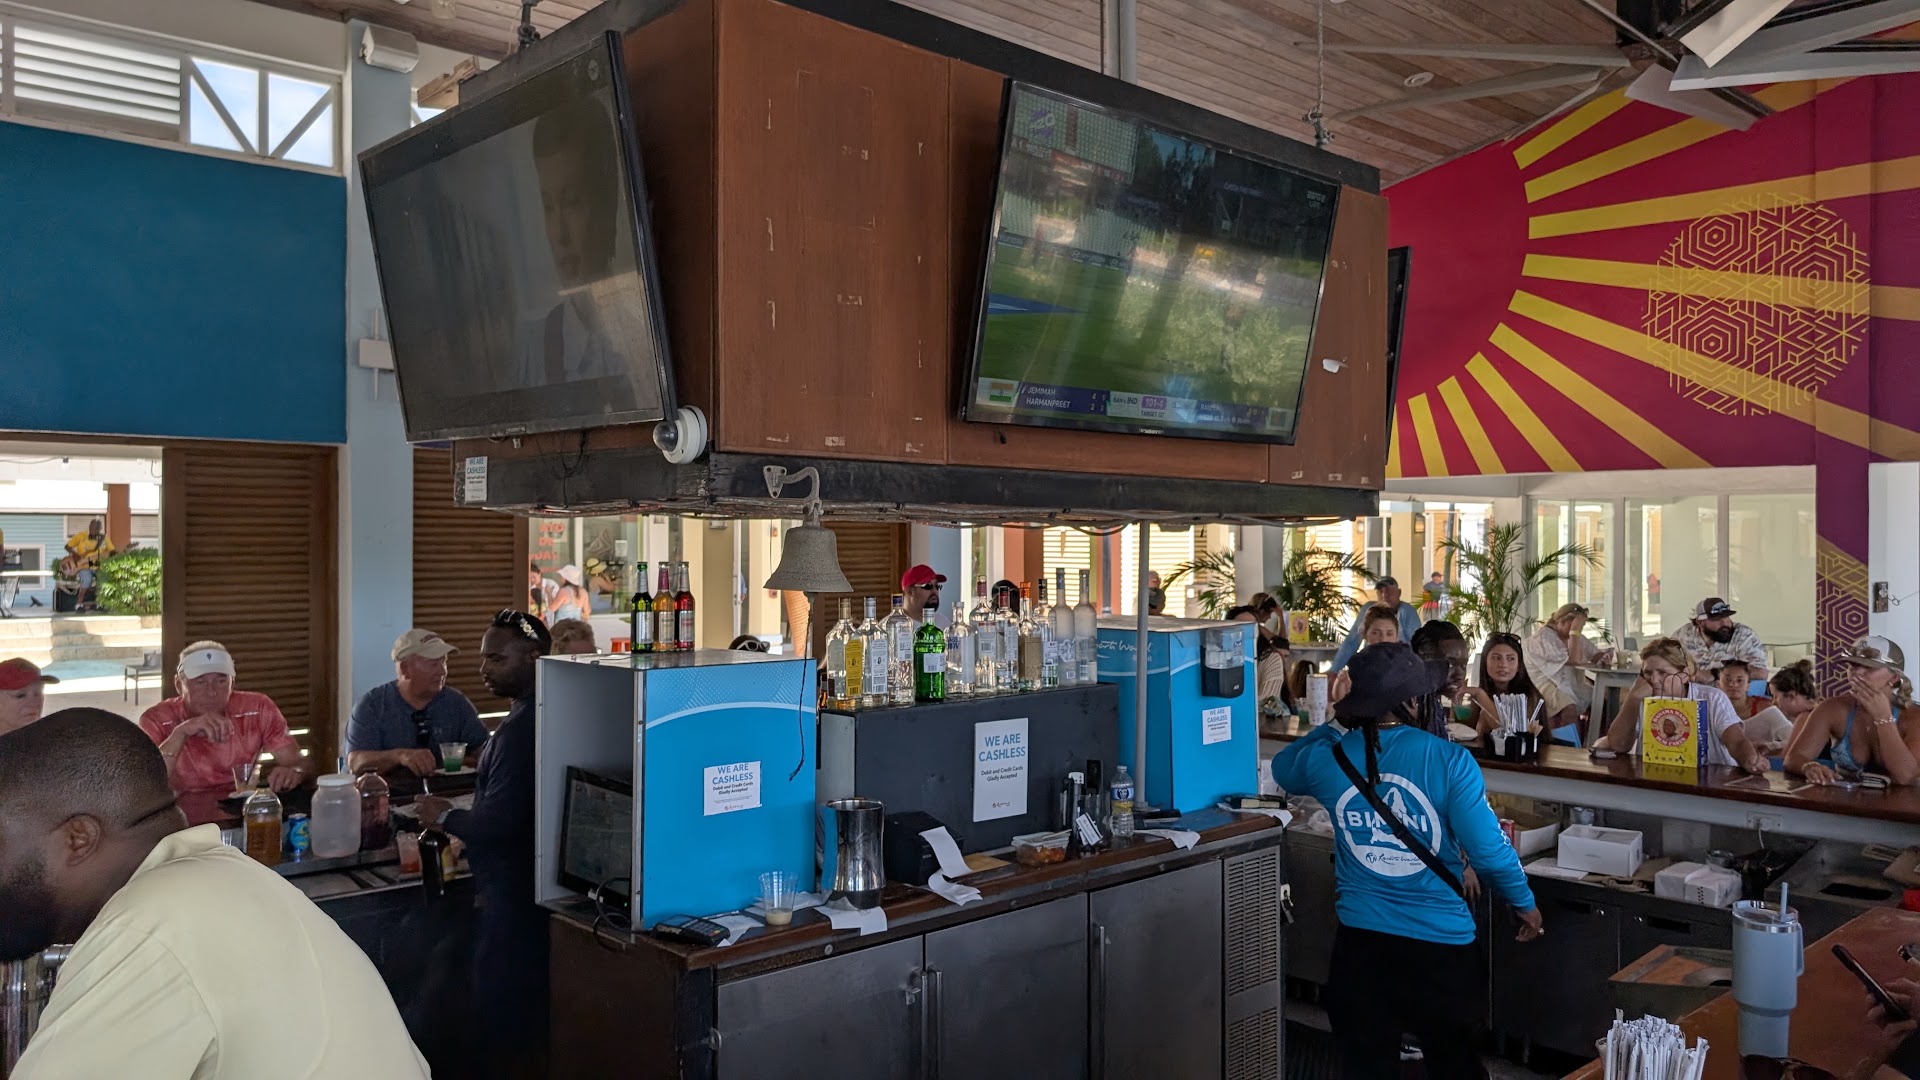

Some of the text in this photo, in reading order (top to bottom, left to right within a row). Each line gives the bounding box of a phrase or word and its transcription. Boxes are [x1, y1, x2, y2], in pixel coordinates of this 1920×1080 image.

[1027, 386, 1056, 396] JEMIMAH
[1026, 398, 1071, 409] HARMANPREET
[1207, 715, 1228, 723] CASHLESS
[985, 734, 1020, 747] WE ARE
[978, 747, 1026, 762] CASHLESS
[718, 764, 748, 774] WE ARE
[712, 772, 754, 784] CASHLESS
[1000, 772, 1018, 780] Accepted
[1346, 810, 1428, 832] BIMNI
